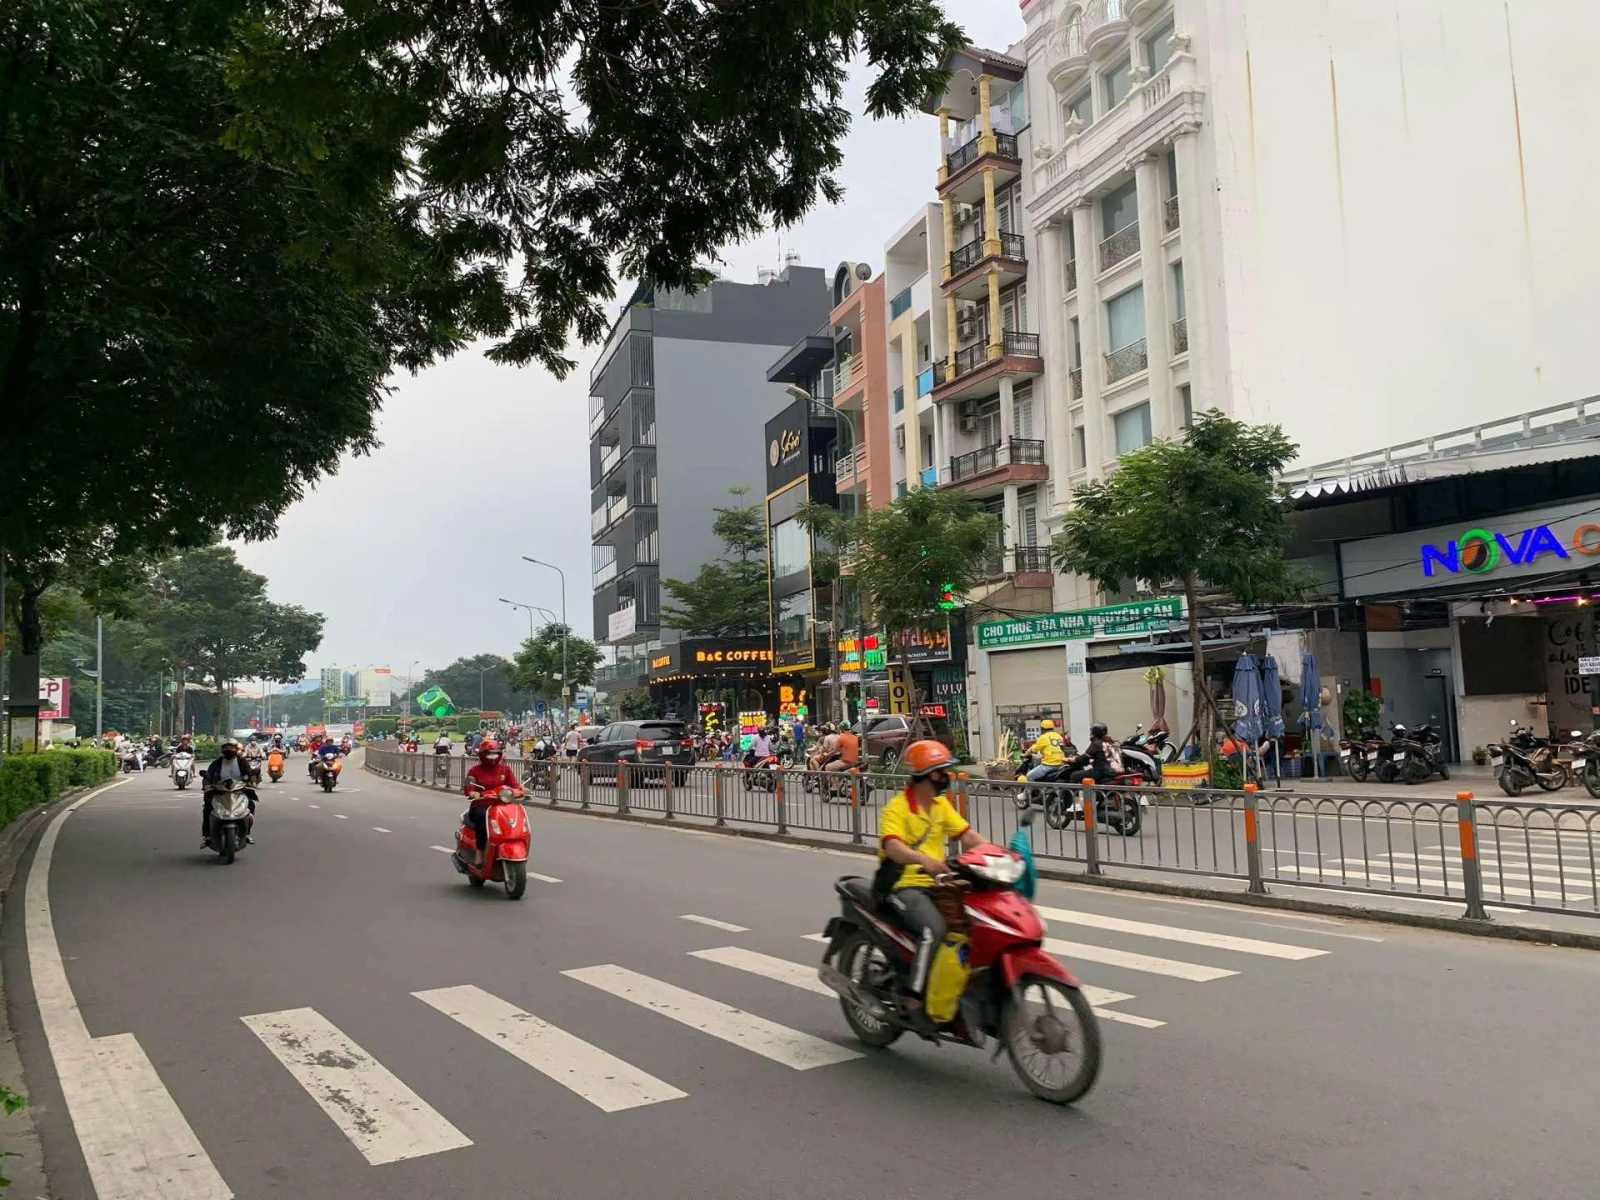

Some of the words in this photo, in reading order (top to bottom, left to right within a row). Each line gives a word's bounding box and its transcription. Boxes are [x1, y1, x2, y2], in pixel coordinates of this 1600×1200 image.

[1421, 524, 1570, 577] NOVA
[983, 625, 1004, 638] CHO
[1143, 603, 1173, 618] CĂN
[696, 650, 723, 662] B&C
